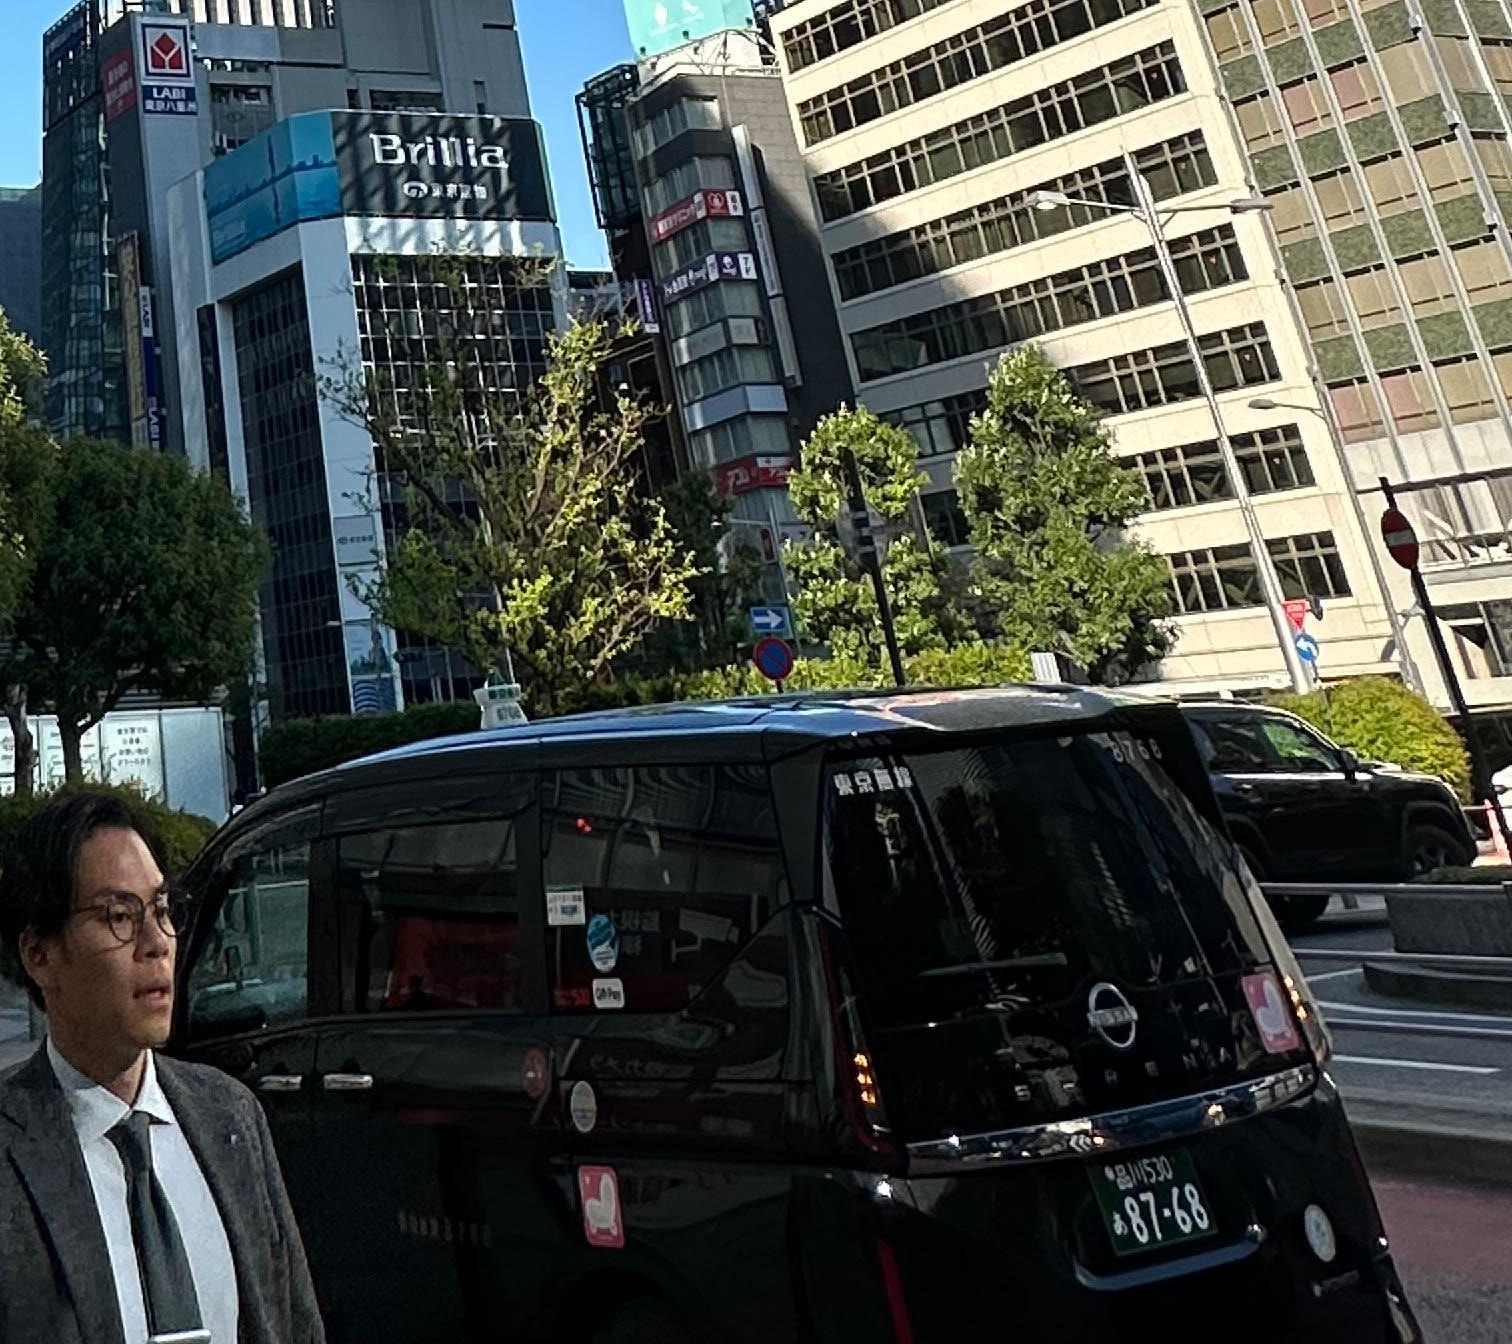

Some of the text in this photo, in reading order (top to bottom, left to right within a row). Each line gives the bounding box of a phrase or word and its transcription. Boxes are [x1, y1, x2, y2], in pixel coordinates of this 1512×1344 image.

[369, 132, 510, 169] Brillia
[1110, 738, 1162, 763] 8768
[1124, 1182, 1210, 1244] 87-68
